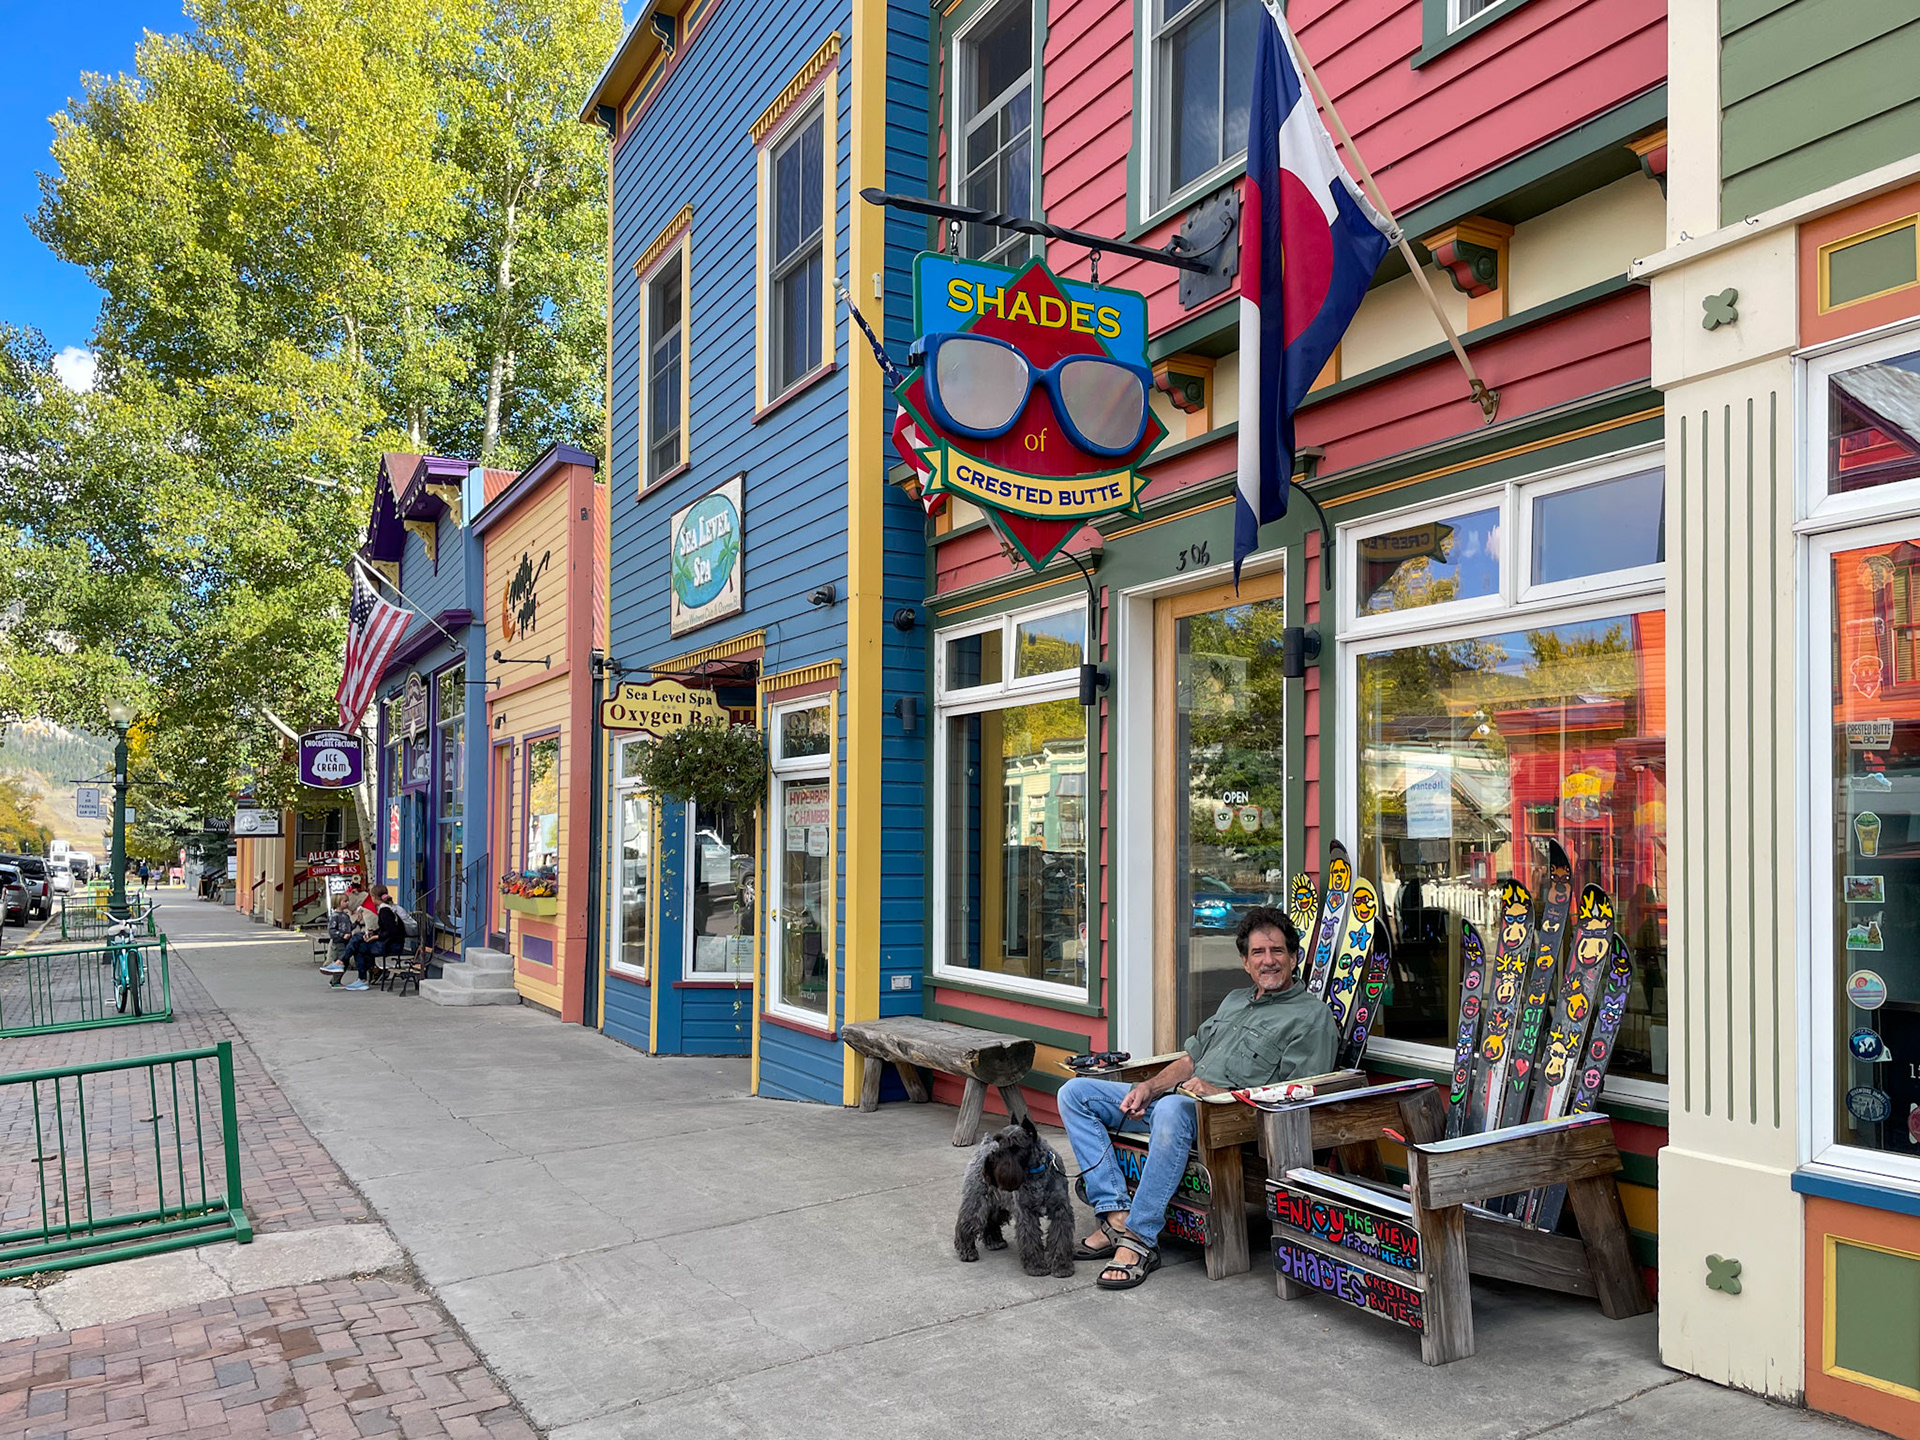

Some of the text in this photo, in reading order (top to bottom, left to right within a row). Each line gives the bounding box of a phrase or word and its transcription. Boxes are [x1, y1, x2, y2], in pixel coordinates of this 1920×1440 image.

[946, 277, 1121, 339] SHADES
[1024, 427, 1048, 452] of
[956, 465, 1123, 506] CRESTED BUTTE
[626, 688, 713, 707] Sea Level Spa
[610, 704, 683, 728] Oxygen
[1872, 724, 1891, 735] BUTTE
[317, 763, 346, 772] CREAM
[325, 754, 338, 762] ICE
[1223, 791, 1249, 804] OPEN
[793, 809, 829, 824] CHAMBER
[308, 850, 360, 863] ALLEY HATS
[1346, 1233, 1414, 1268] FROM HERE
[1365, 1275, 1420, 1305] CRESTED
[1370, 1292, 1407, 1319] BUTTE
